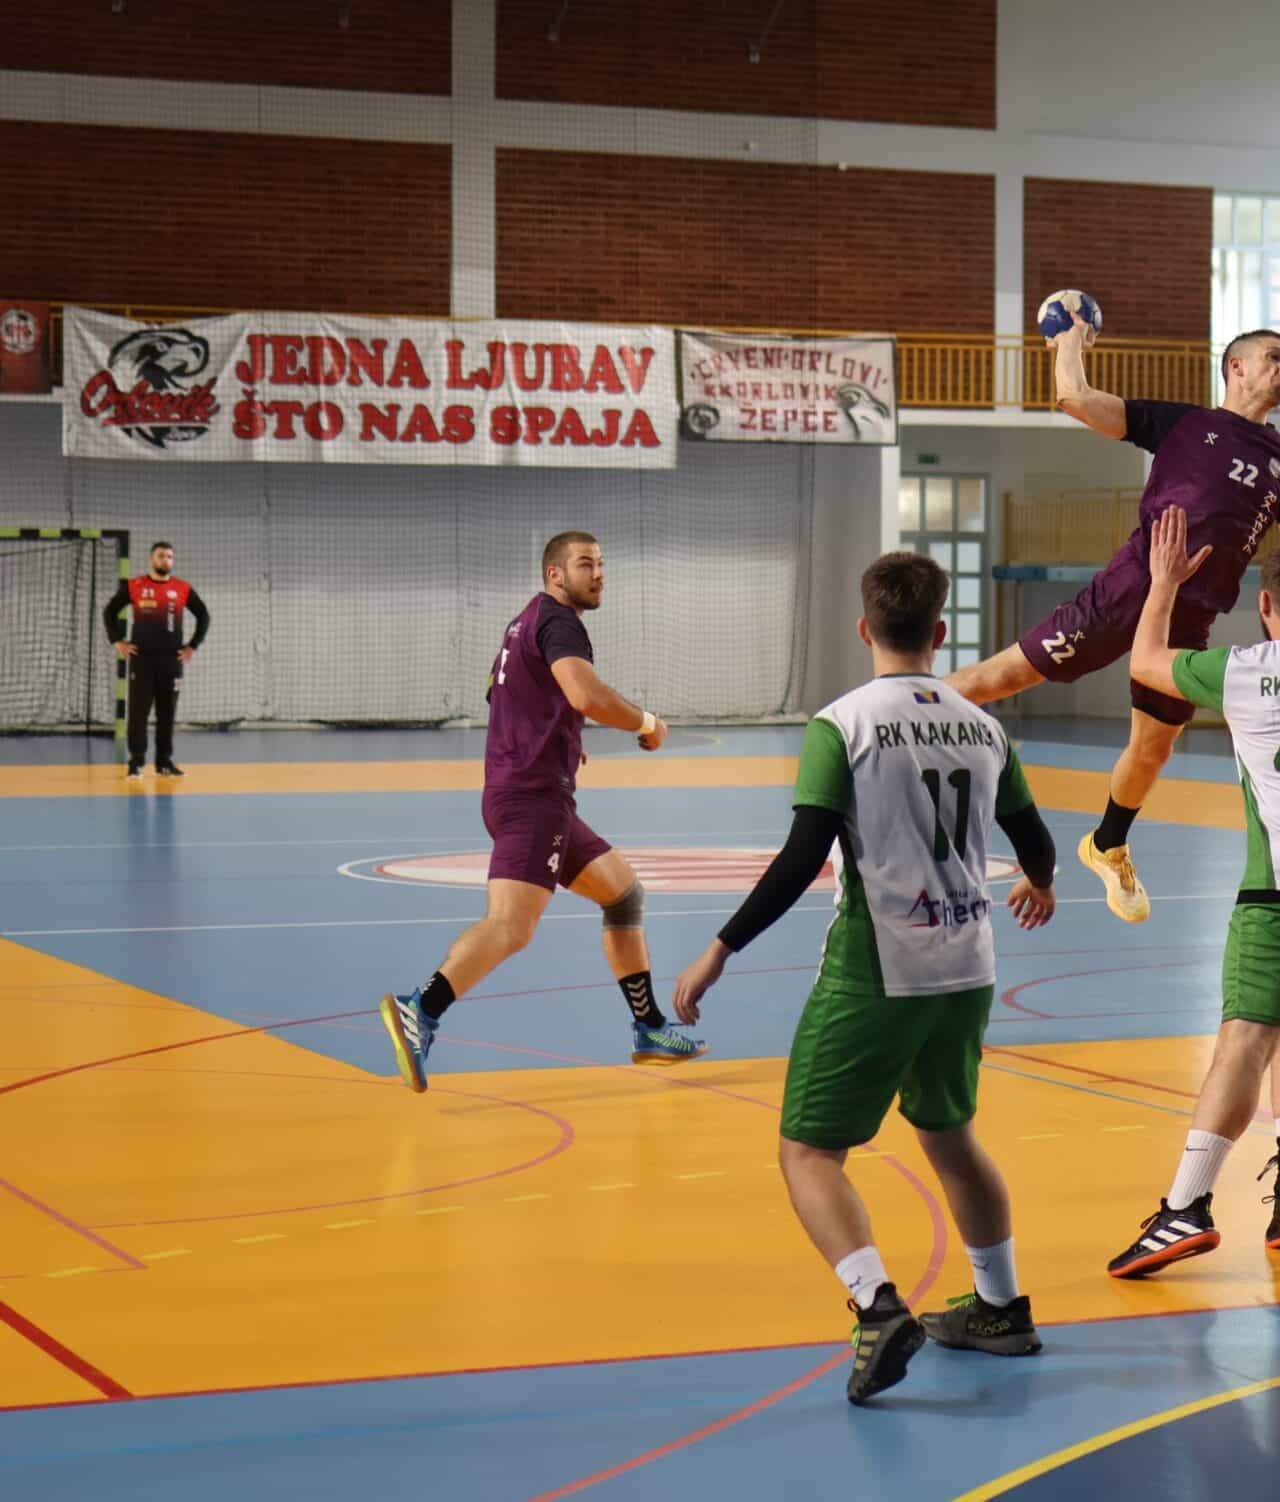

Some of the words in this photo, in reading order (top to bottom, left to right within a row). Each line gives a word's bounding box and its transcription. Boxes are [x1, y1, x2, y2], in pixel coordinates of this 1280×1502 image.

[235, 334, 430, 388] JEDNA
[445, 339, 655, 393] LJUBAV
[232, 388, 344, 440] ŠTO
[359, 403, 475, 444] NAS
[490, 405, 662, 447] SPAJA
[1229, 458, 1258, 488] 22
[1041, 631, 1076, 664] 22
[875, 721, 908, 749] RK
[921, 769, 971, 862] 11
[547, 852, 559, 873] 4
